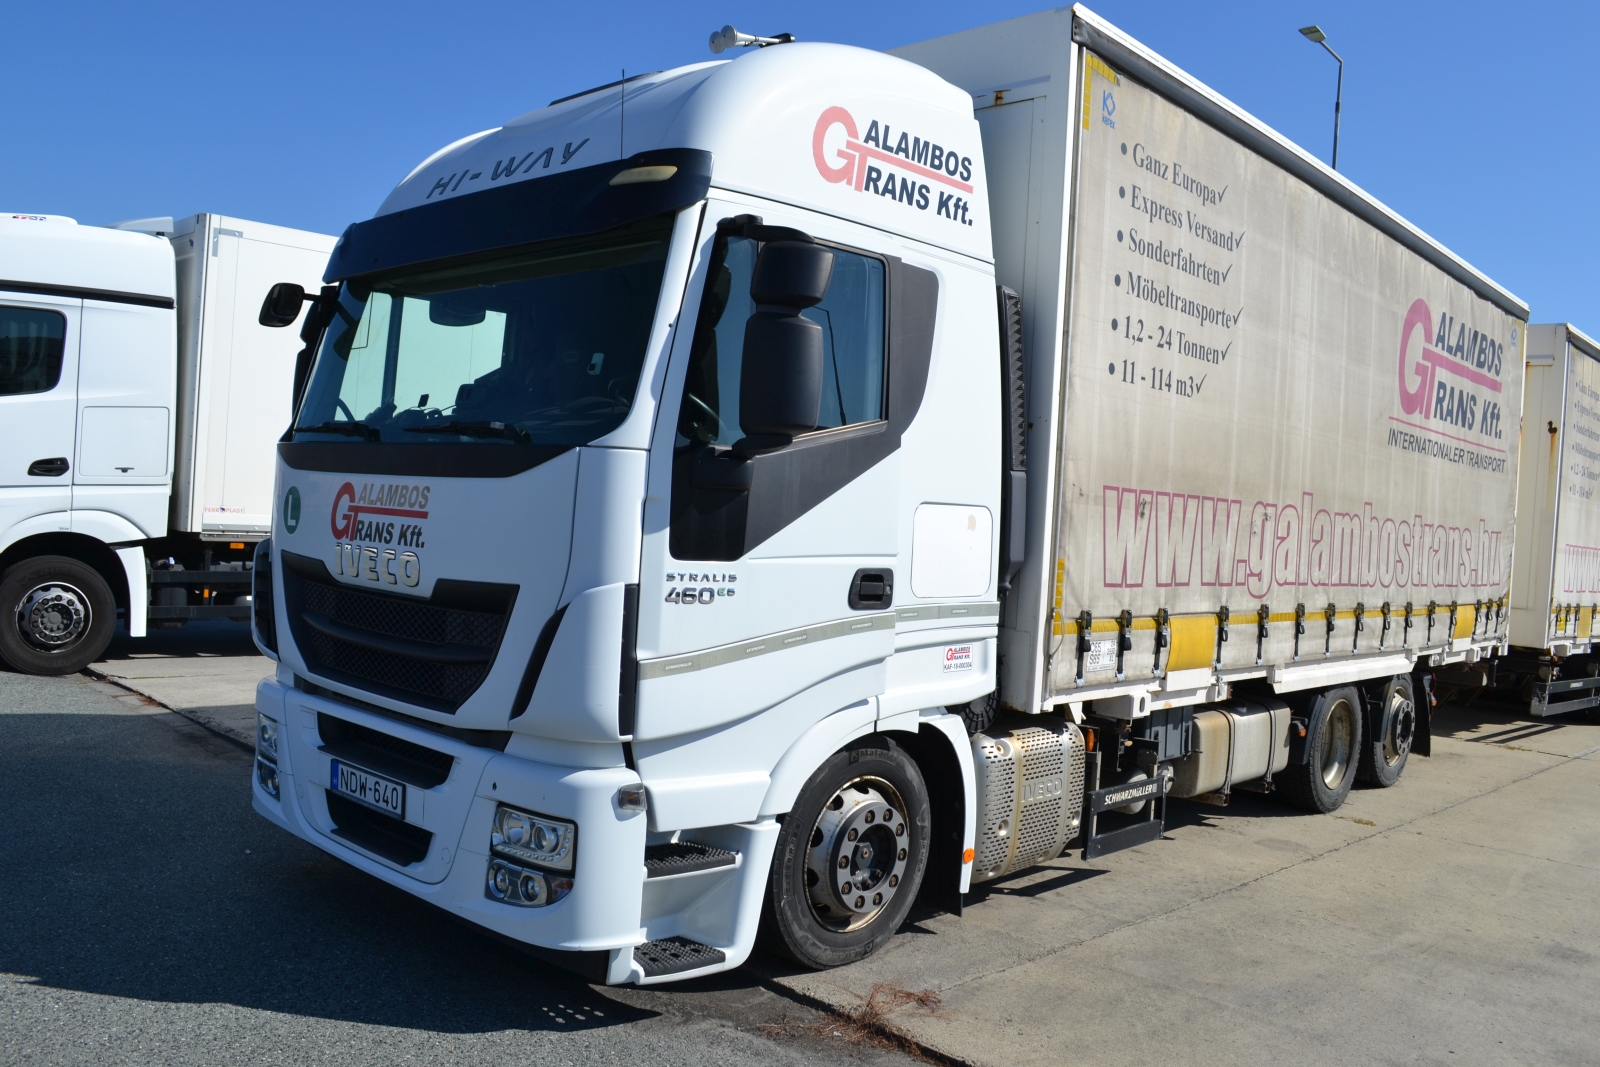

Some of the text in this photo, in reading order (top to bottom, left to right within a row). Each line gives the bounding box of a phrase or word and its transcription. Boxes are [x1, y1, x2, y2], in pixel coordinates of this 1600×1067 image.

[1102, 114, 1116, 129] kerex
[1132, 143, 1216, 207] Ganz Europa
[936, 191, 974, 227] Kft.
[1131, 184, 1234, 252] Express Versand
[1128, 228, 1221, 286] Sonderfahrten
[1126, 270, 1232, 329] Möbeltransporte
[1124, 315, 1144, 346] 1,2
[1157, 325, 1173, 351] 24
[1176, 330, 1220, 365] Tonnen
[1121, 359, 1136, 385] 11
[1150, 366, 1172, 393] 114
[1175, 376, 1195, 398] m3
[1480, 399, 1503, 440] Kft.
[1387, 428, 1506, 474] INTERNATIONALER TRANSPORT
[287, 494, 297, 527] L
[397, 523, 425, 549] Kft.
[1102, 484, 1502, 600] www.galambostrans.hu
[335, 541, 421, 588] IVECO
[666, 571, 738, 583] STRALIS
[664, 586, 716, 605] 460
[340, 767, 399, 811] NDW-640
[1021, 778, 1063, 803] IVECO
[1104, 784, 1153, 806] SCHWARZMÜLLER
